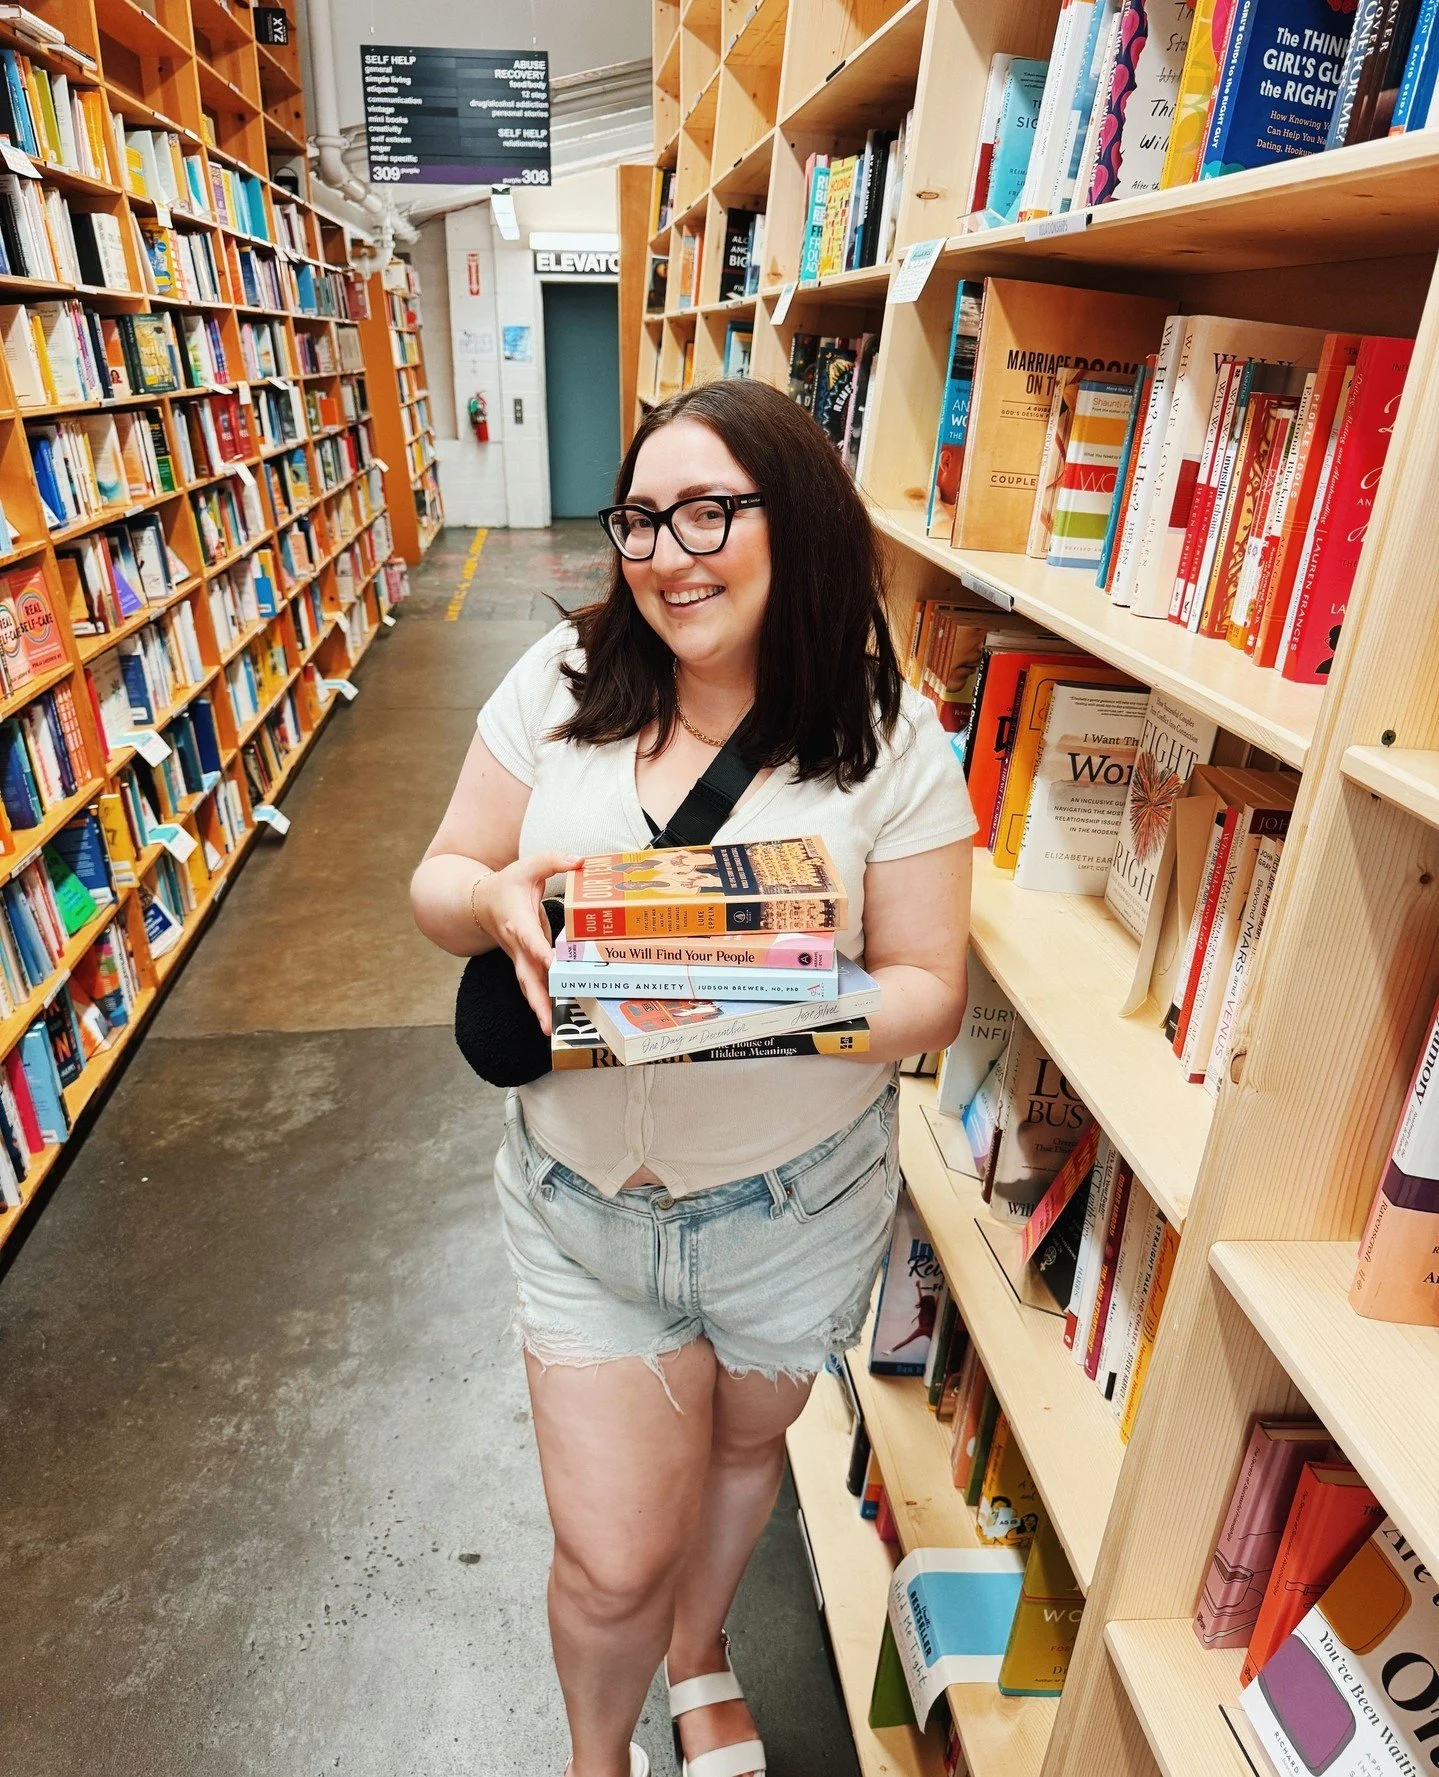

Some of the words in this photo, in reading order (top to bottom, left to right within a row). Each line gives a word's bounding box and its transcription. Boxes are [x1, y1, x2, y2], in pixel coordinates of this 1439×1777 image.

[272, 17, 284, 42] XYZ
[1276, 27, 1299, 47] The
[365, 56, 390, 64] SELF
[391, 56, 416, 66] HELP
[365, 66, 392, 74] general
[513, 60, 546, 70] ABUSE
[1263, 48, 1316, 78] GIRL'S
[365, 75, 390, 84] simple
[391, 76, 412, 86] living
[494, 70, 546, 80] RECOVERY
[510, 80, 546, 90] food/body
[367, 86, 398, 94] etiquette
[530, 91, 547, 100] step
[1224, 78, 1233, 95] the
[1260, 80, 1282, 98] the
[1284, 80, 1337, 110] RIGHT
[367, 96, 422, 104] communication
[368, 105, 395, 114] vintage
[470, 100, 514, 108] drug/alcohol
[516, 100, 549, 108] addiction
[1216, 95, 1229, 126] RIGHT
[368, 116, 384, 124] mini
[386, 116, 408, 124] books
[492, 109, 522, 118] personal
[522, 110, 549, 118] stories
[1270, 110, 1288, 122] How
[1289, 114, 1322, 130] Knowing
[368, 125, 402, 134] creativity
[371, 136, 384, 144] self
[498, 128, 522, 138] SELF
[523, 129, 548, 138] HELP
[1266, 126, 1282, 136] Can
[1283, 129, 1300, 140] Help
[1302, 133, 1316, 142] You
[370, 145, 392, 154] anger
[503, 140, 548, 149] relationships
[1256, 138, 1283, 152] Dating,
[371, 154, 388, 162] male
[390, 154, 418, 164] specific
[373, 166, 401, 181] 309
[522, 170, 549, 184] 308
[1132, 180, 1150, 190] After
[1160, 323, 1174, 362] Why
[1178, 334, 1194, 382] WHY
[1026, 374, 1046, 395] ON
[1152, 365, 1168, 421] Him?
[1214, 380, 1226, 412] Why
[1208, 415, 1220, 435] We
[1291, 386, 1312, 456] Emotional
[1302, 394, 1321, 448] PEOPLE
[1142, 423, 1154, 465] Why
[1201, 439, 1214, 471] Love
[1154, 442, 1172, 498] LOVE
[1218, 456, 1232, 501] invisible
[1290, 454, 1307, 498] TOOLS
[1132, 465, 1148, 512] Her?
[1275, 460, 1294, 524] Blackmail
[1208, 503, 1222, 540] chains
[1274, 535, 1286, 568] ALAN
[1304, 538, 1324, 590] LAUREN
[25, 602, 42, 616] REAL
[1290, 594, 1310, 652] FRANCES
[973, 672, 983, 696] Days
[971, 698, 978, 711] of
[965, 710, 976, 742] Dating
[1091, 734, 1120, 746] Want
[1140, 720, 1199, 780] FIGHT
[1054, 806, 1092, 815] NAVIGATING
[1080, 798, 1112, 807] INCLUSIVE
[1055, 815, 1098, 826] RELATIONSHIP
[1218, 833, 1230, 858] What
[1045, 852, 1094, 862] ELIZABETH
[582, 878, 613, 898] OUR
[1210, 864, 1222, 894] Makes
[1204, 898, 1214, 922] Love
[1247, 878, 1264, 921] Beyond
[586, 913, 596, 932] OUR
[603, 910, 613, 934] TEAM
[605, 948, 626, 960] You
[628, 948, 652, 960] Will
[656, 949, 682, 960] Find
[685, 950, 713, 962] Your
[716, 950, 755, 964] People
[1236, 923, 1262, 975] MARS
[561, 982, 630, 990] UNWINDING
[636, 983, 684, 991] ANXIETY
[1230, 976, 1242, 997] and
[642, 1035, 658, 1054] One
[660, 1034, 684, 1051] Day
[700, 1020, 749, 1044] December
[1213, 1000, 1240, 1058] VENUS
[710, 1048, 746, 1058] Hidden
[750, 1046, 797, 1056] Meanings
[1092, 1159, 1104, 1194] ACT
[1086, 1193, 1096, 1219] with
[1082, 1218, 1094, 1242] love
[1366, 1200, 1388, 1264] Ravenscroft
[1148, 1224, 1162, 1271] STRAIGHT
[1138, 1298, 1145, 1313] NO
[1130, 1312, 1143, 1350] CHASER
[1136, 1342, 1147, 1380] Heather
[910, 1590, 933, 1657] BESTSELLER
[1318, 1630, 1354, 1683] You've
[1350, 1682, 1382, 1727] Been
[1274, 1732, 1298, 1774] RICHARD
